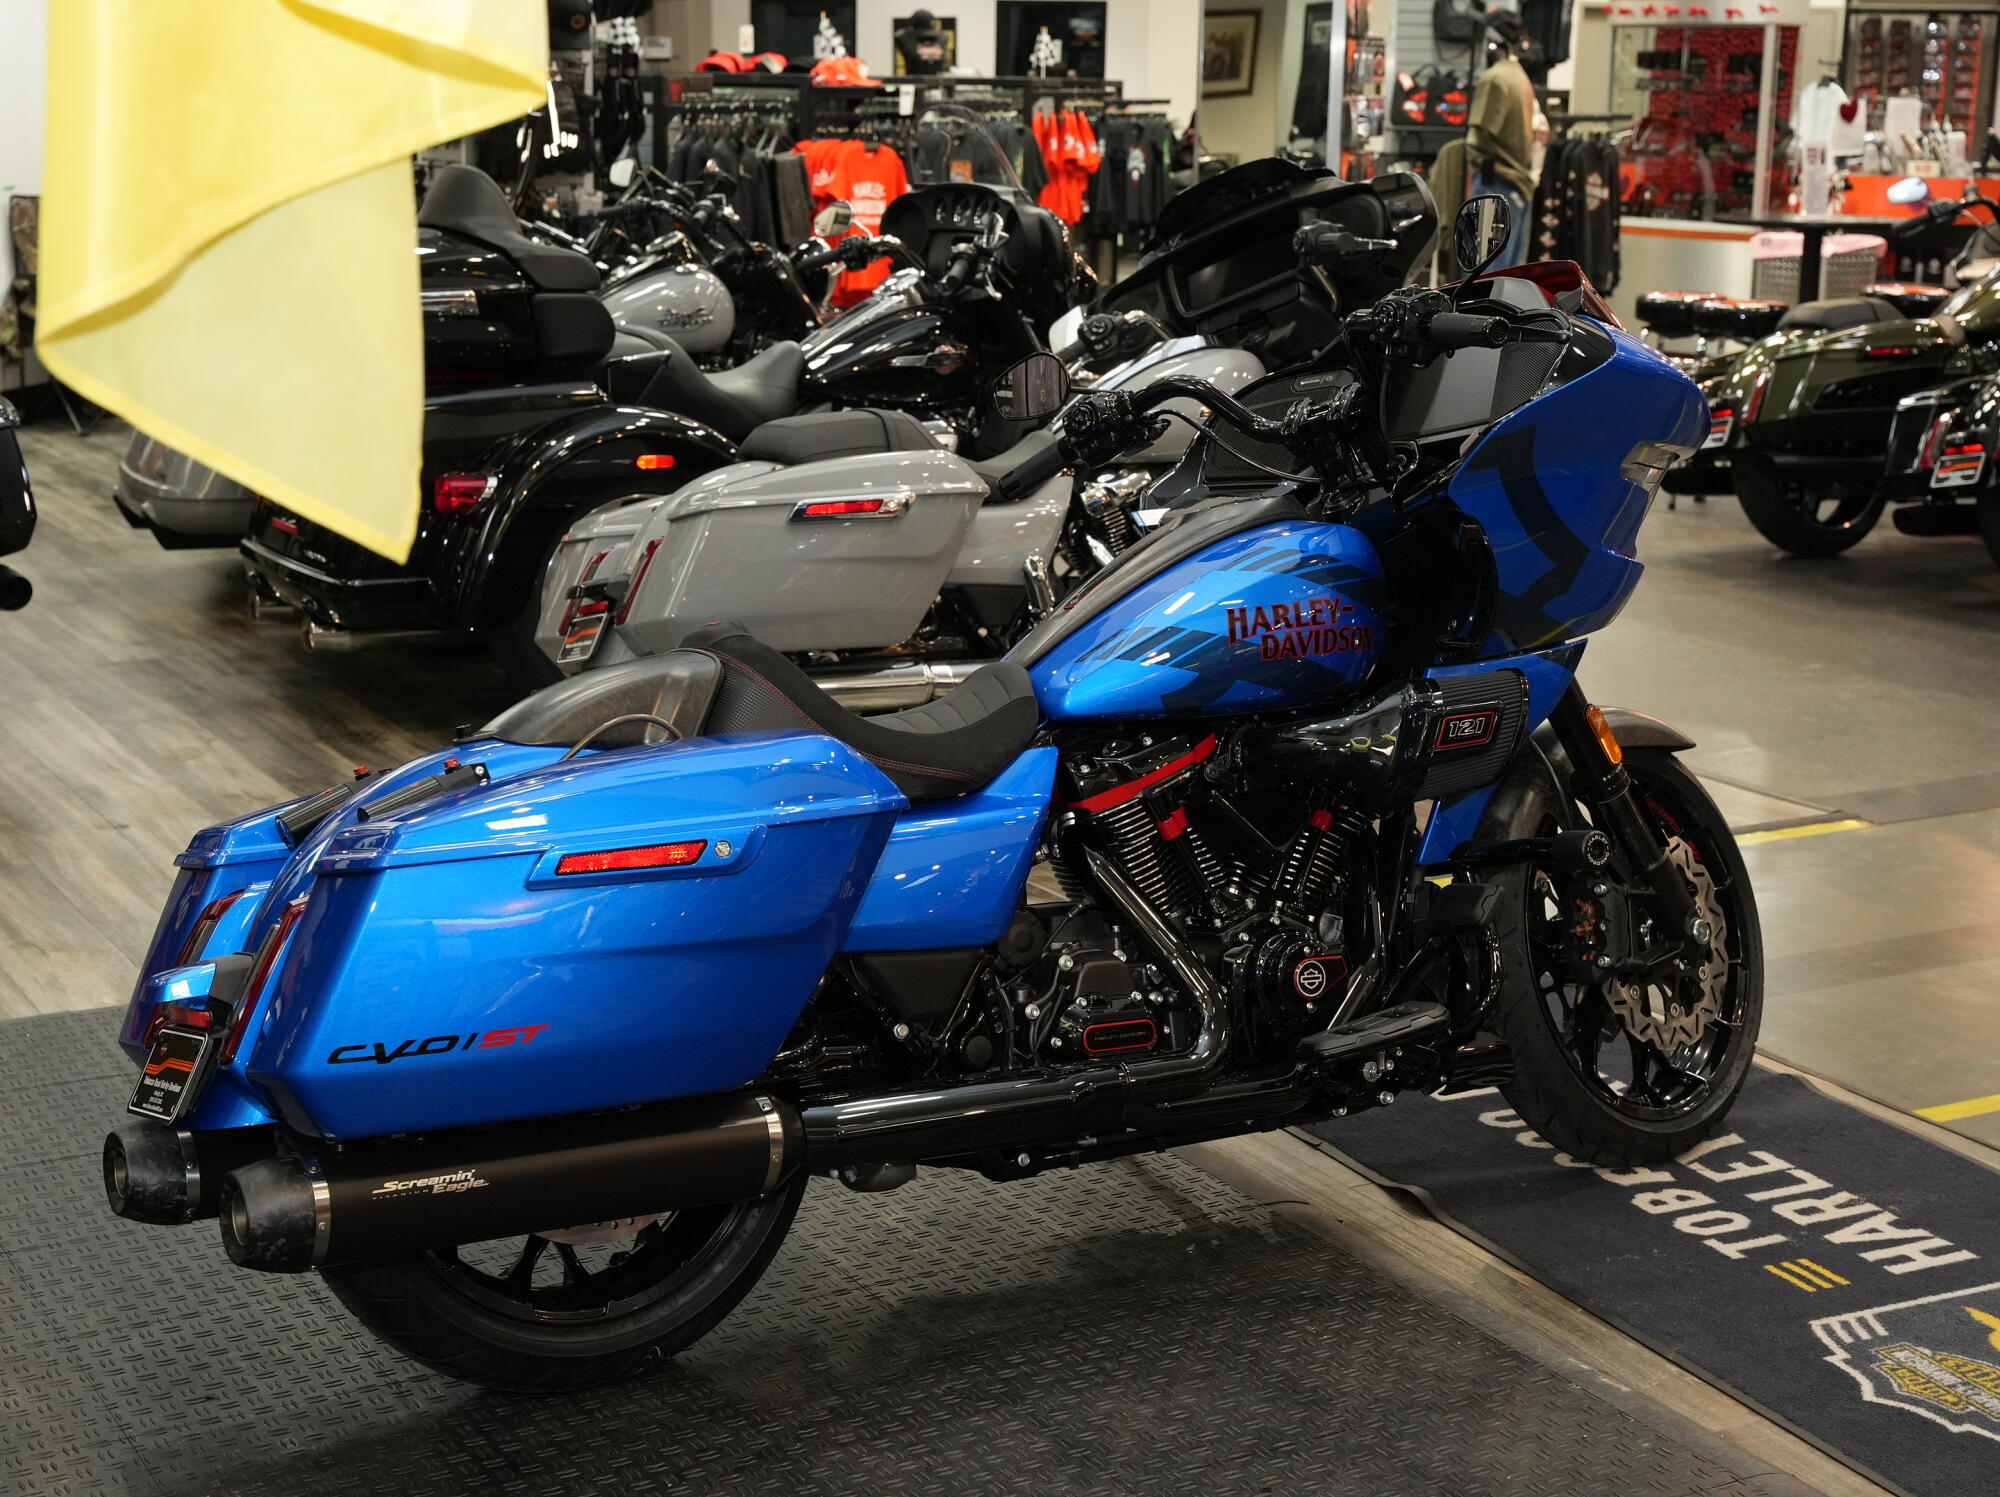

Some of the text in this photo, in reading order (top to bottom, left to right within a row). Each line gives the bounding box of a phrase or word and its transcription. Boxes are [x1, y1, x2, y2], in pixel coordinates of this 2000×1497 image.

[1227, 597, 1354, 646] HARLEY-
[1261, 625, 1373, 661] DAVIDSON
[1448, 717, 1485, 738] 121
[432, 1177, 491, 1195] Eagle
